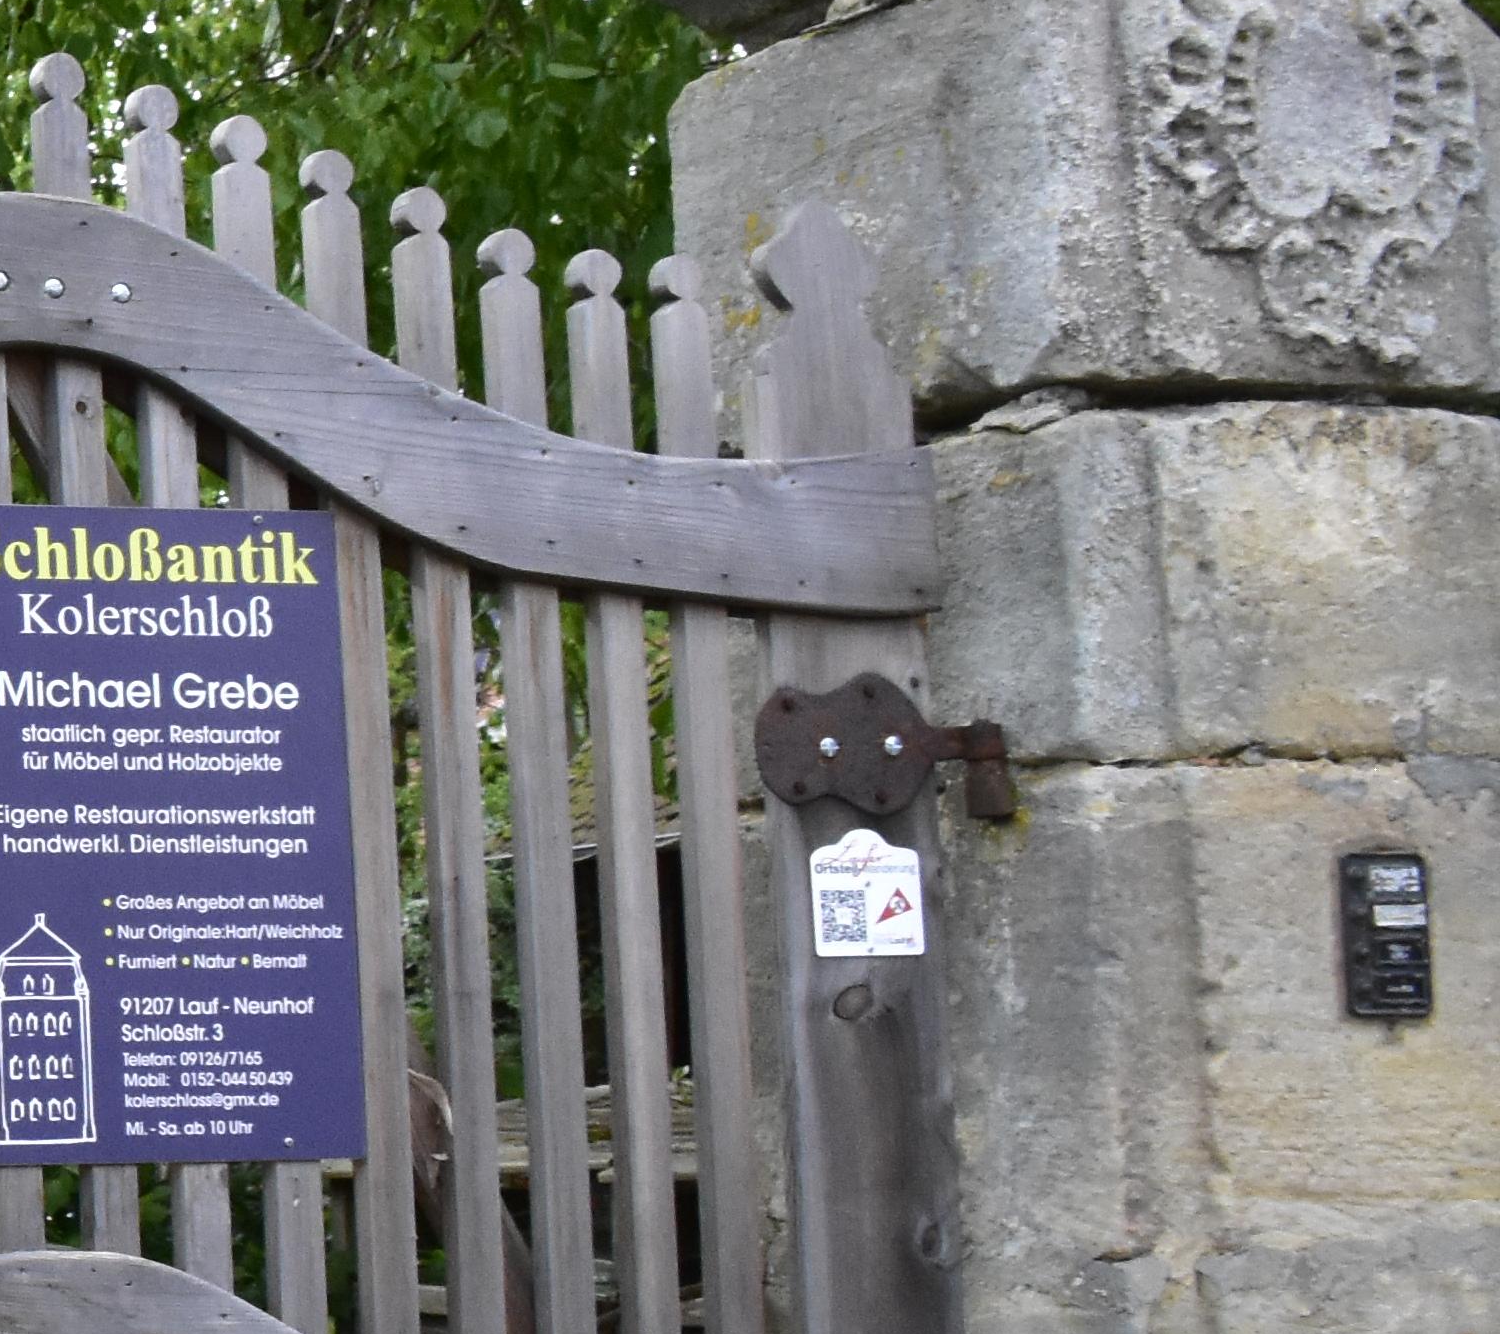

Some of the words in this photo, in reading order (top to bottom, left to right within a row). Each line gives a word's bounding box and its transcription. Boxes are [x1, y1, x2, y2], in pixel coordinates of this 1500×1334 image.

[18, 593, 274, 638] Kolerschloß
[173, 672, 300, 711] Grebe
[21, 724, 106, 744] staatlich
[112, 727, 165, 748] gepr.
[169, 724, 282, 745] Restaurator
[22, 750, 49, 771] für
[53, 751, 119, 772] Möbel
[123, 752, 163, 772] und
[167, 752, 283, 776] Holzobjekte
[74, 804, 316, 827] Restaurationswerkstatt
[3, 833, 126, 855] handwerkl.
[130, 834, 309, 859] Dienstleistungen
[115, 894, 174, 911] Großes
[176, 895, 246, 914] Angebot
[247, 897, 270, 910] an
[272, 894, 325, 910] Möbel
[117, 924, 146, 940] Nur
[118, 953, 177, 969] Furniert
[193, 953, 237, 969] Natur
[252, 952, 308, 969] Bemalt
[120, 997, 174, 1016] 91207
[178, 997, 221, 1016] Lauf
[233, 996, 315, 1015] Neunhof
[121, 1023, 210, 1043] Schloßstr.
[212, 1023, 224, 1042] 3
[122, 1052, 177, 1067] Telefon:
[179, 1051, 263, 1067] 09126/7165
[123, 1072, 170, 1087] Mobil:
[124, 1092, 280, 1110] kolerschloss@gmx.de
[183, 1120, 206, 1135] ab
[209, 1120, 226, 1135] 10
[228, 1120, 254, 1135] Uhr
